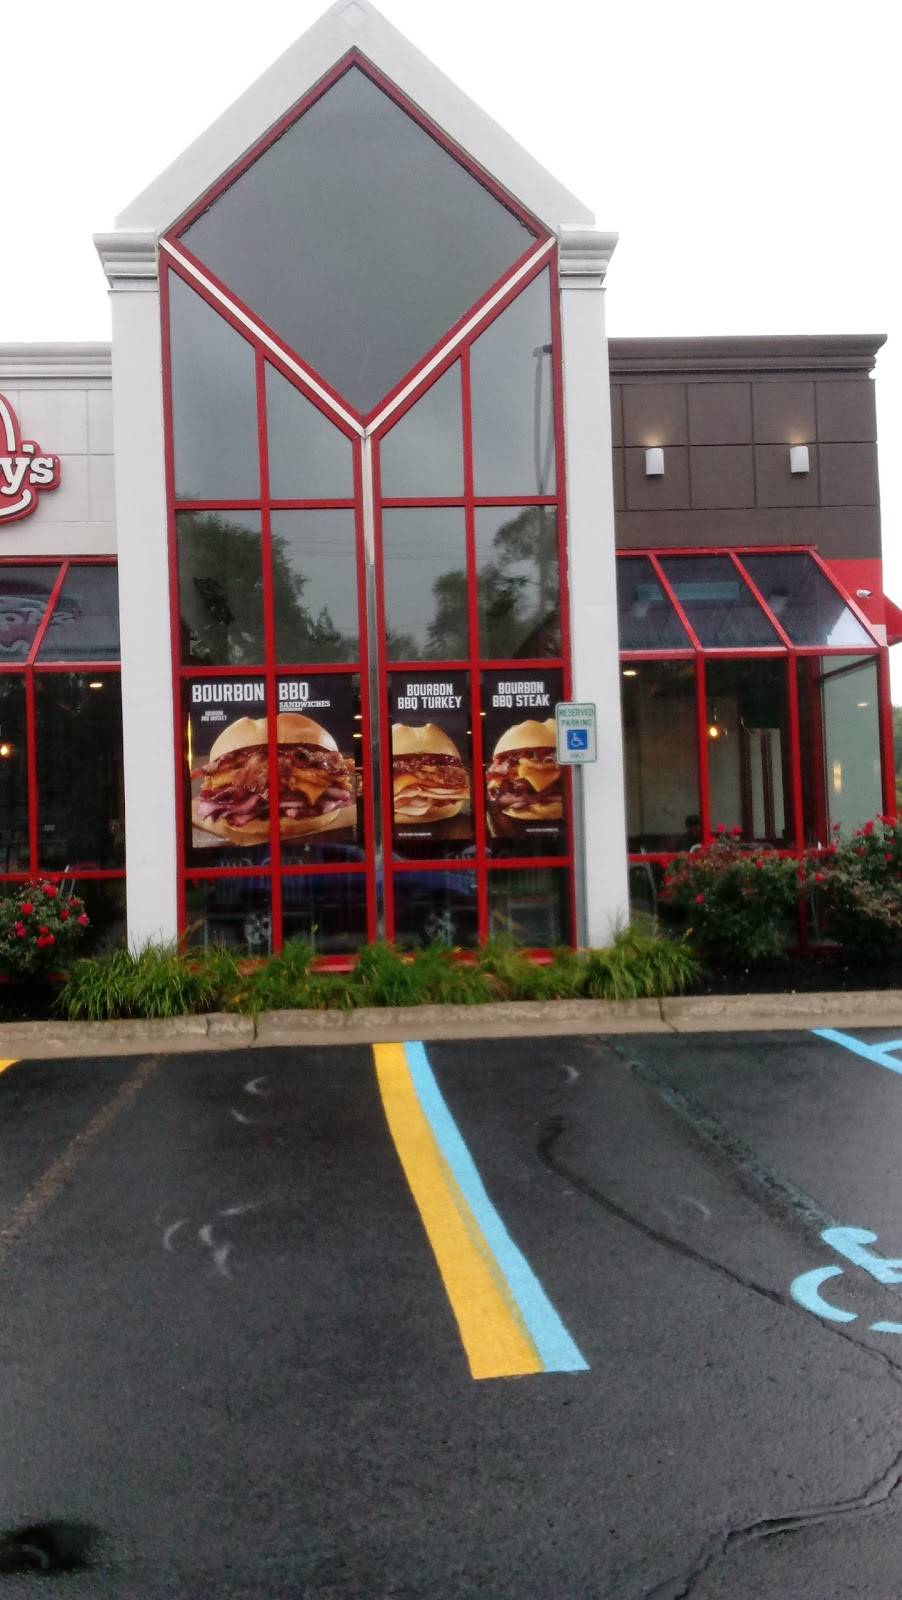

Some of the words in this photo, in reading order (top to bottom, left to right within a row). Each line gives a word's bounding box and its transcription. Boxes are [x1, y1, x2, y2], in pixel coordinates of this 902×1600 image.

[192, 683, 265, 702] BOURBON
[278, 682, 309, 702] BBQ
[406, 683, 453, 697] BOURBON
[498, 682, 545, 695] BOURBON
[279, 700, 331, 708] SANDWICHES
[397, 696, 418, 710] BBQ
[422, 696, 463, 709] TURKEY
[492, 695, 513, 708] BBQ
[515, 694, 550, 707] STEAK
[560, 719, 593, 728] PARKING
